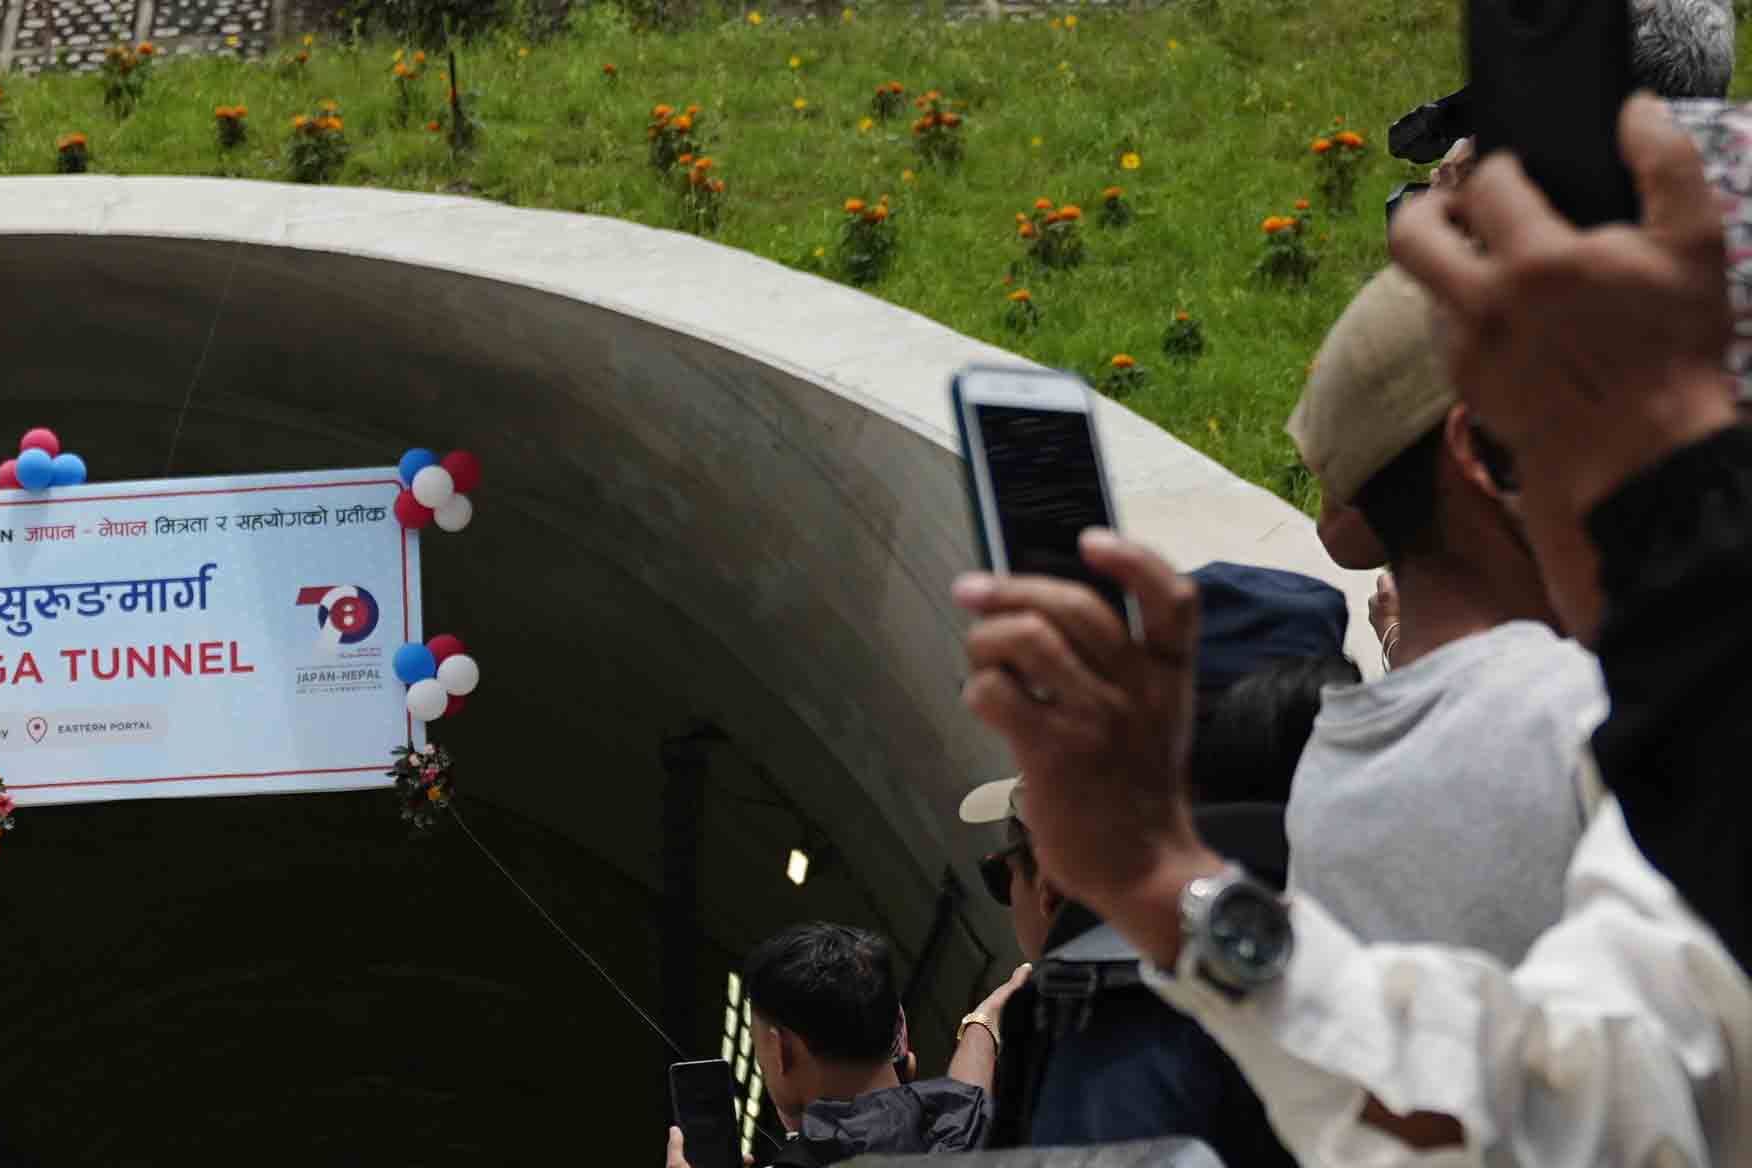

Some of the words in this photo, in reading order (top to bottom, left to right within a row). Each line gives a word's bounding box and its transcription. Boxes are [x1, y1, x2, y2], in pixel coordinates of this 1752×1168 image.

[23, 524, 76, 543] जापान
[97, 517, 147, 540] नेपाल
[155, 515, 209, 535] मित्रता
[216, 518, 227, 532] र
[236, 505, 328, 532] सहयोगको
[334, 504, 388, 528] प्रतीक
[60, 641, 255, 682] TUNNEL
[296, 669, 381, 685] JAPAN-NEPAL
[57, 723, 107, 735] EASTERN
[110, 721, 153, 733] PORTAL
